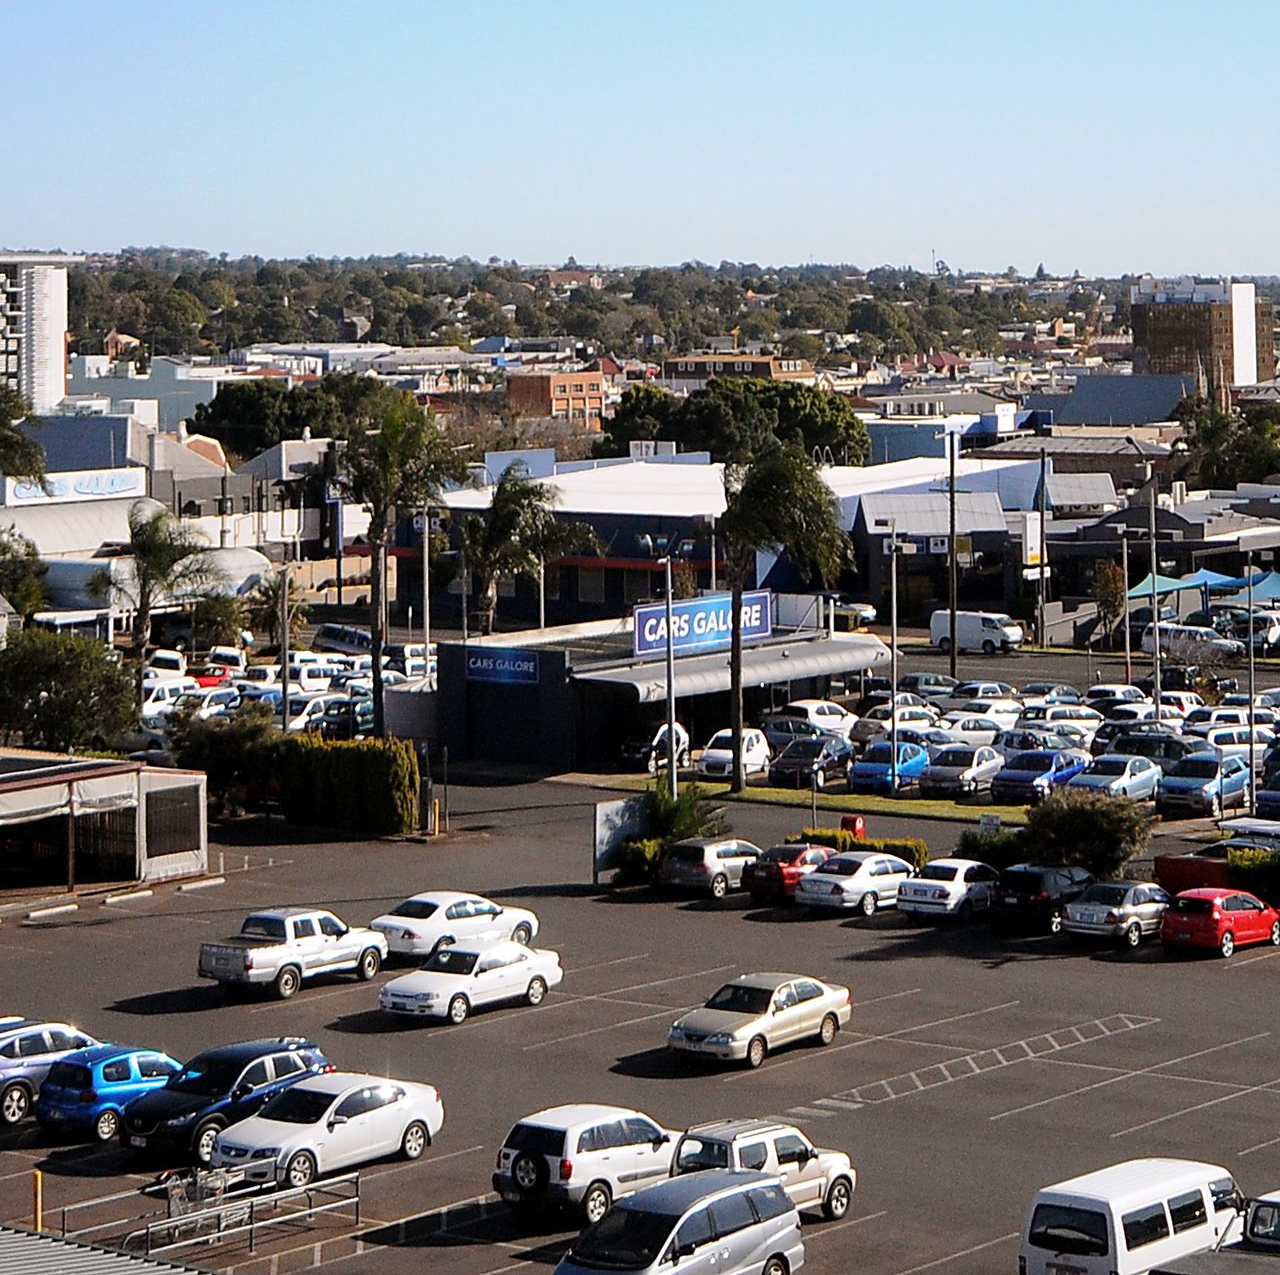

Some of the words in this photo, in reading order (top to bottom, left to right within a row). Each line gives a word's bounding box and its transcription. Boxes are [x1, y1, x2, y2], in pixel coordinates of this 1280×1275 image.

[644, 613, 690, 643] CARS
[693, 604, 762, 634] GALRE
[469, 657, 494, 670] CARS
[495, 660, 535, 673] GALORE
